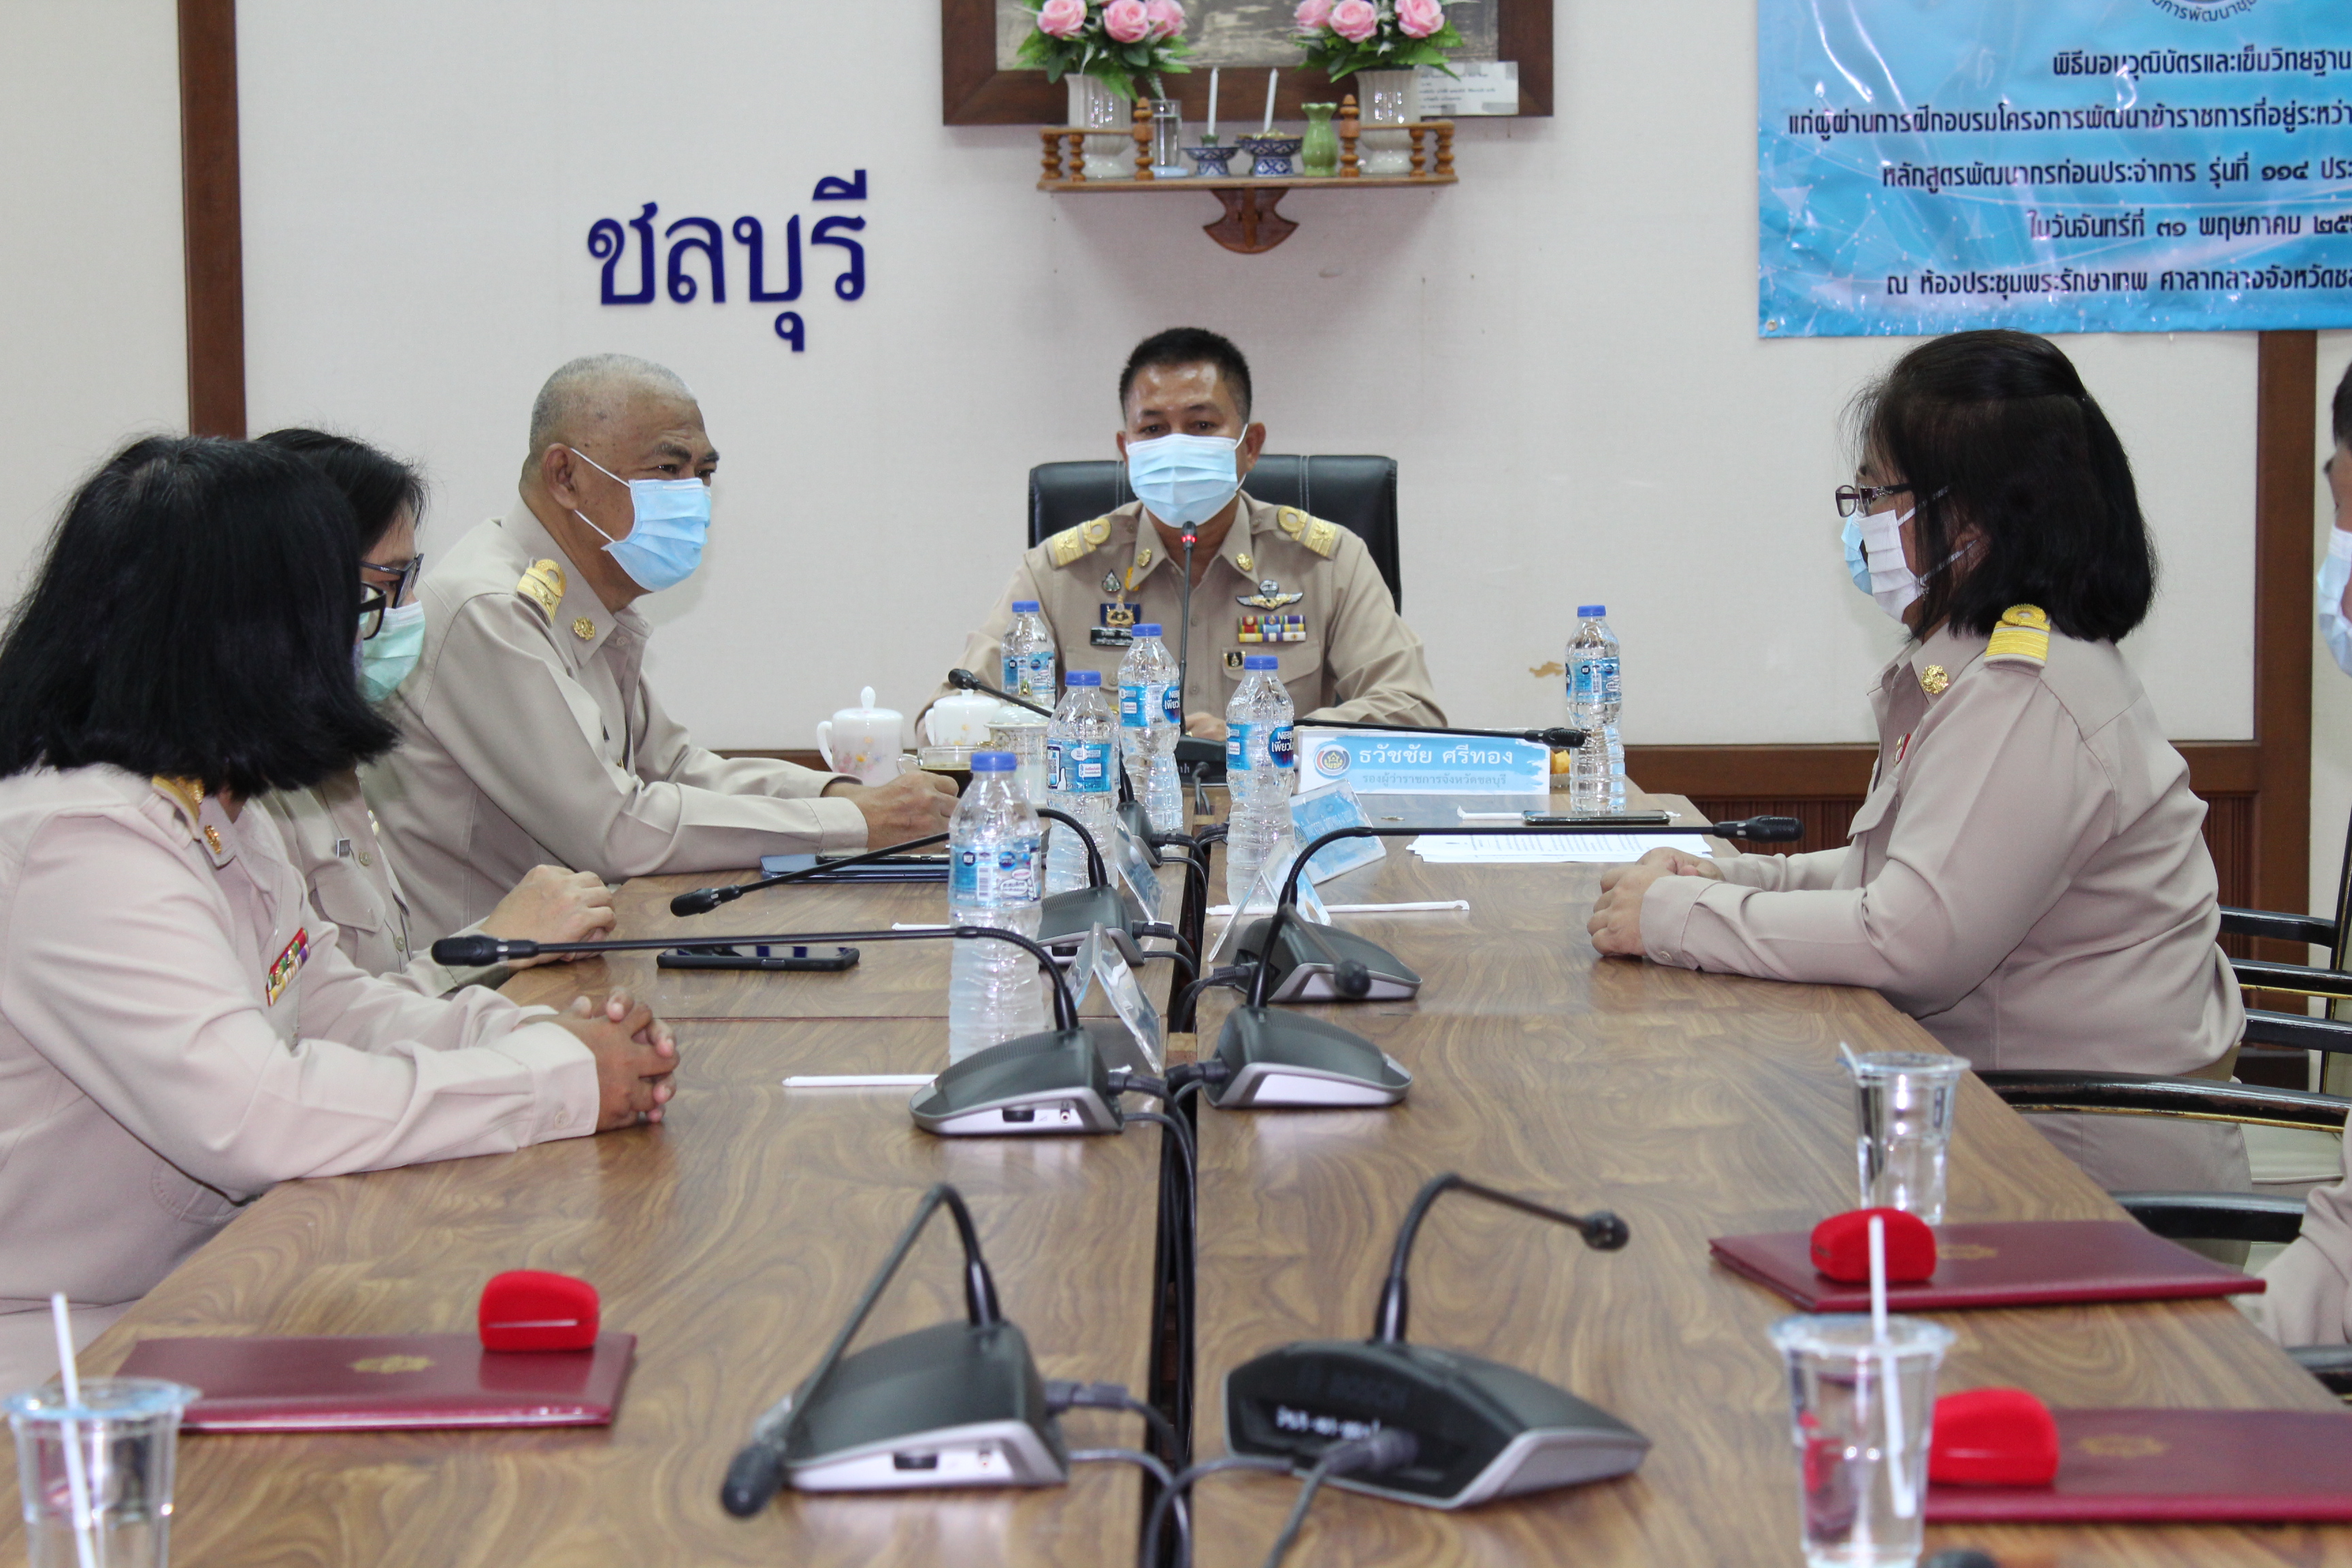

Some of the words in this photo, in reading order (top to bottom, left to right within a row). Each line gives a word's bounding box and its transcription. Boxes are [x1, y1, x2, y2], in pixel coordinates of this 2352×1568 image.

[2208, 152, 2249, 189] รุ่นที่
[2261, 161, 2309, 180] ๑๑๔
[2027, 208, 2145, 240] ในวันจันทร์ที่
[2156, 220, 2187, 238] ๓๑
[2199, 214, 2302, 241] พฤษภาคม
[2314, 215, 2352, 234] ๒๕
[587, 169, 867, 353] ชลบุรี
[1887, 276, 1908, 295] ณ
[1359, 744, 1432, 764] ธวัชชัย
[1443, 746, 1513, 765] ศรีทอง
